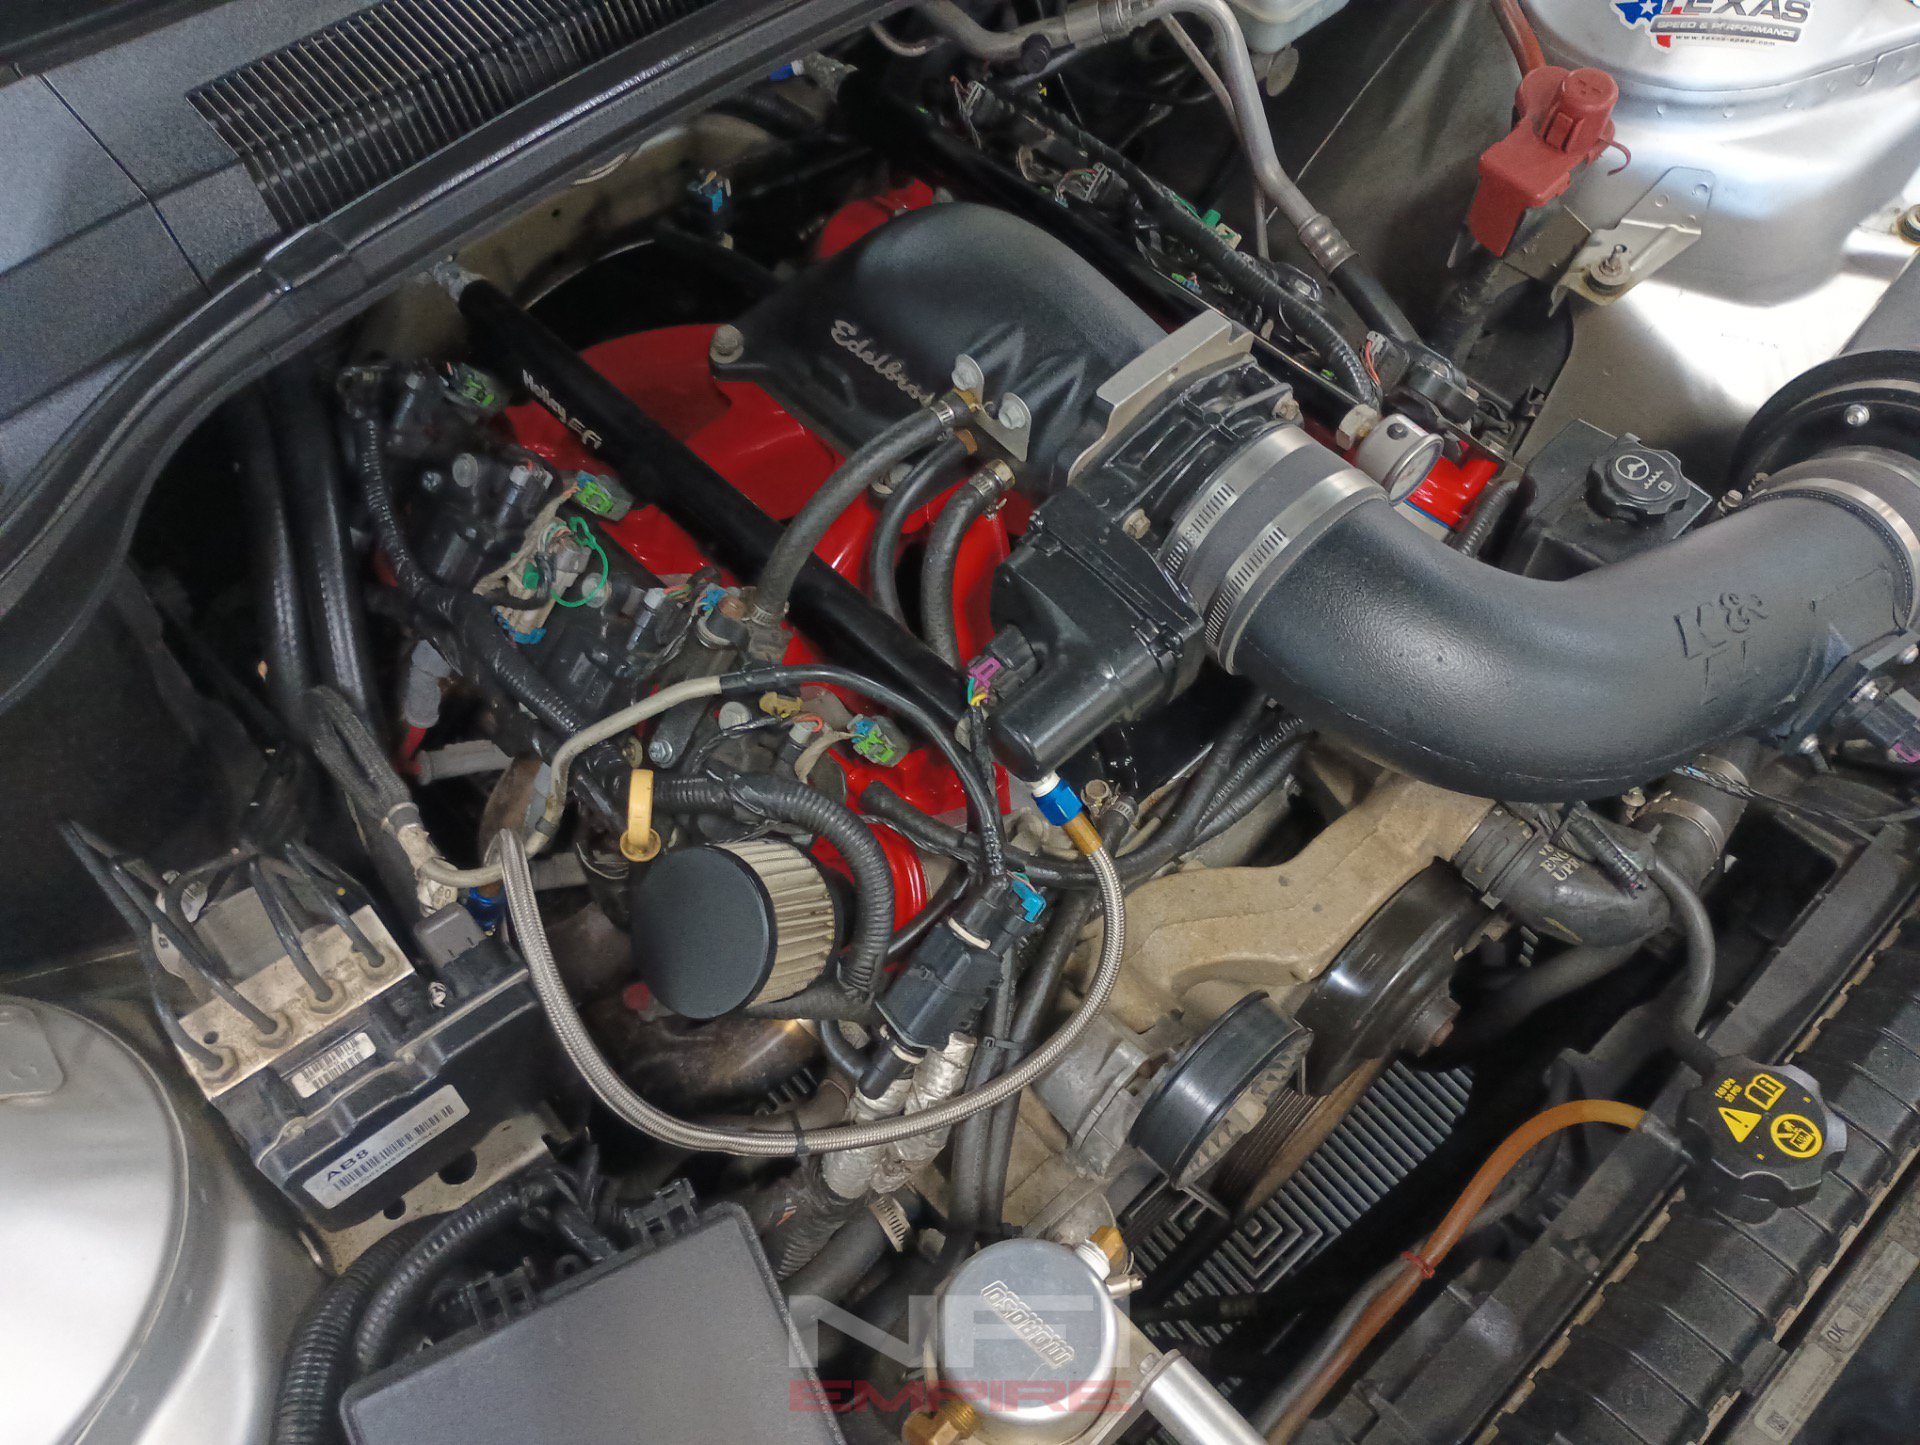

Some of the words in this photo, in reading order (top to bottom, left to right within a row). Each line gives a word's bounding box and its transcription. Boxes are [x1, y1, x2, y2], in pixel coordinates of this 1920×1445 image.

[1656, 20, 1697, 30] SPEED
[327, 1149, 369, 1182] AB8
[1826, 1322, 1849, 1344] OK
